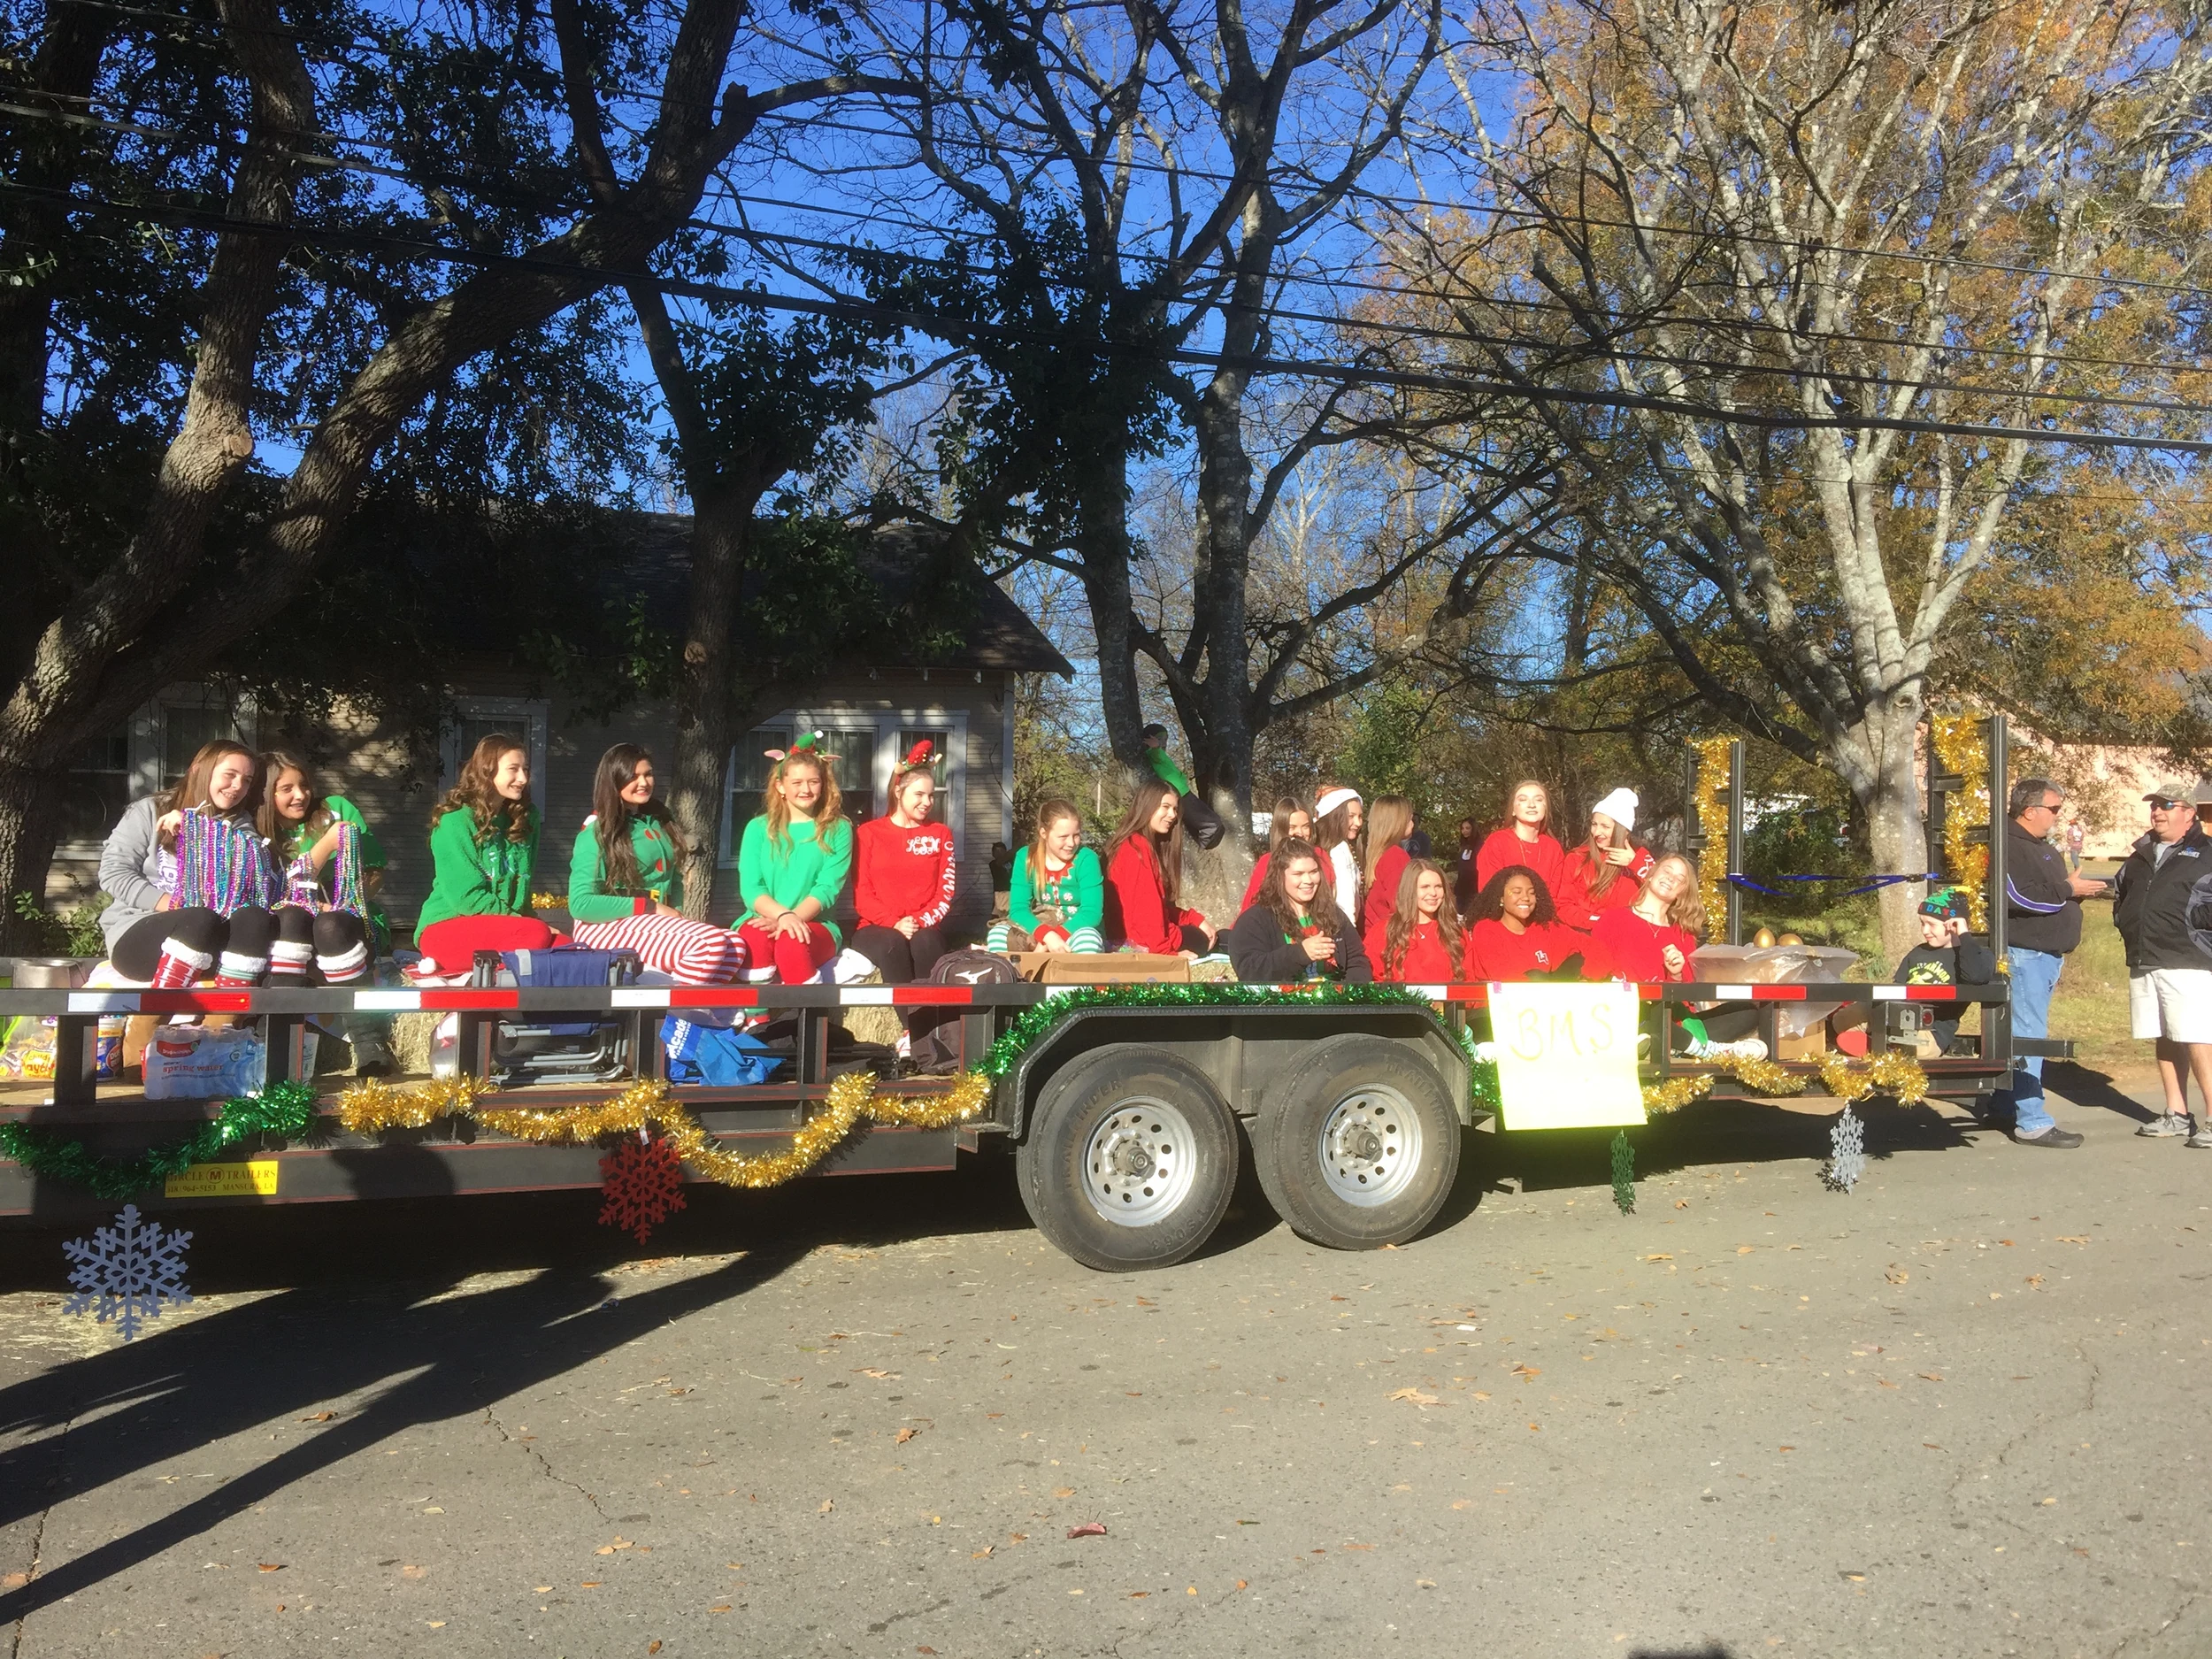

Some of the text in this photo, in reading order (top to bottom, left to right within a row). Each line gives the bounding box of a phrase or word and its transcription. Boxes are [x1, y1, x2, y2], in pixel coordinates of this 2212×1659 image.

[1509, 1003, 1613, 1061] BMS
[163, 1064, 194, 1073] spring
[226, 1169, 276, 1180] TRAILERS
